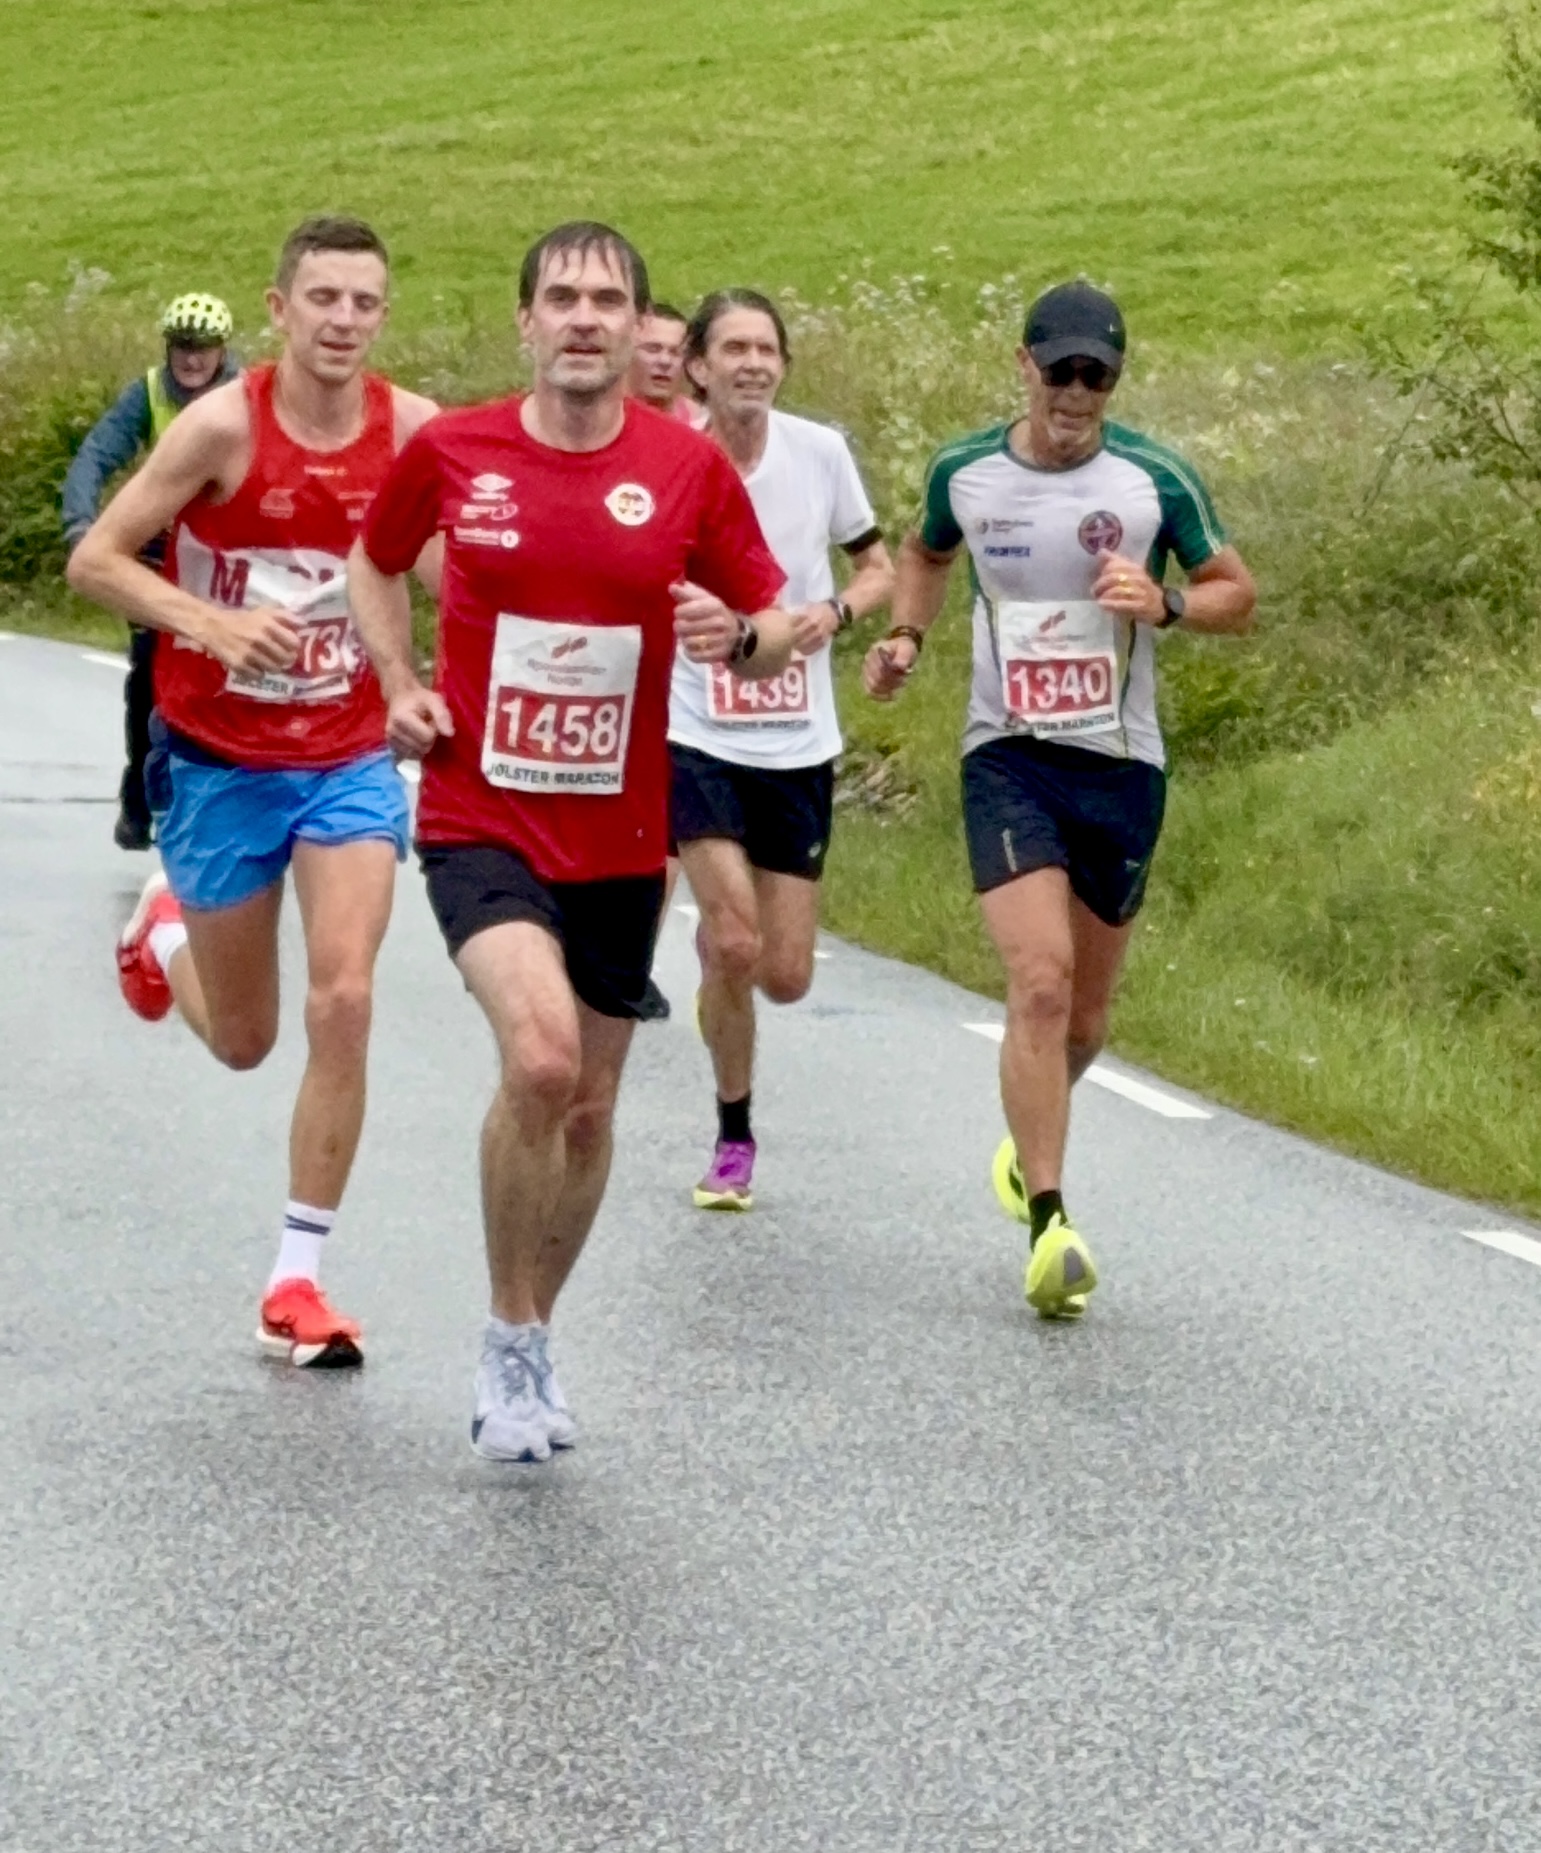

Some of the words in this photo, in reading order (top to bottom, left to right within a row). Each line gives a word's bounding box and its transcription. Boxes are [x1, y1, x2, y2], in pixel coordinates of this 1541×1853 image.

[297, 625, 342, 673] 73
[714, 666, 804, 710] 1439
[1012, 662, 1108, 711] 1340
[501, 696, 620, 757] 1458
